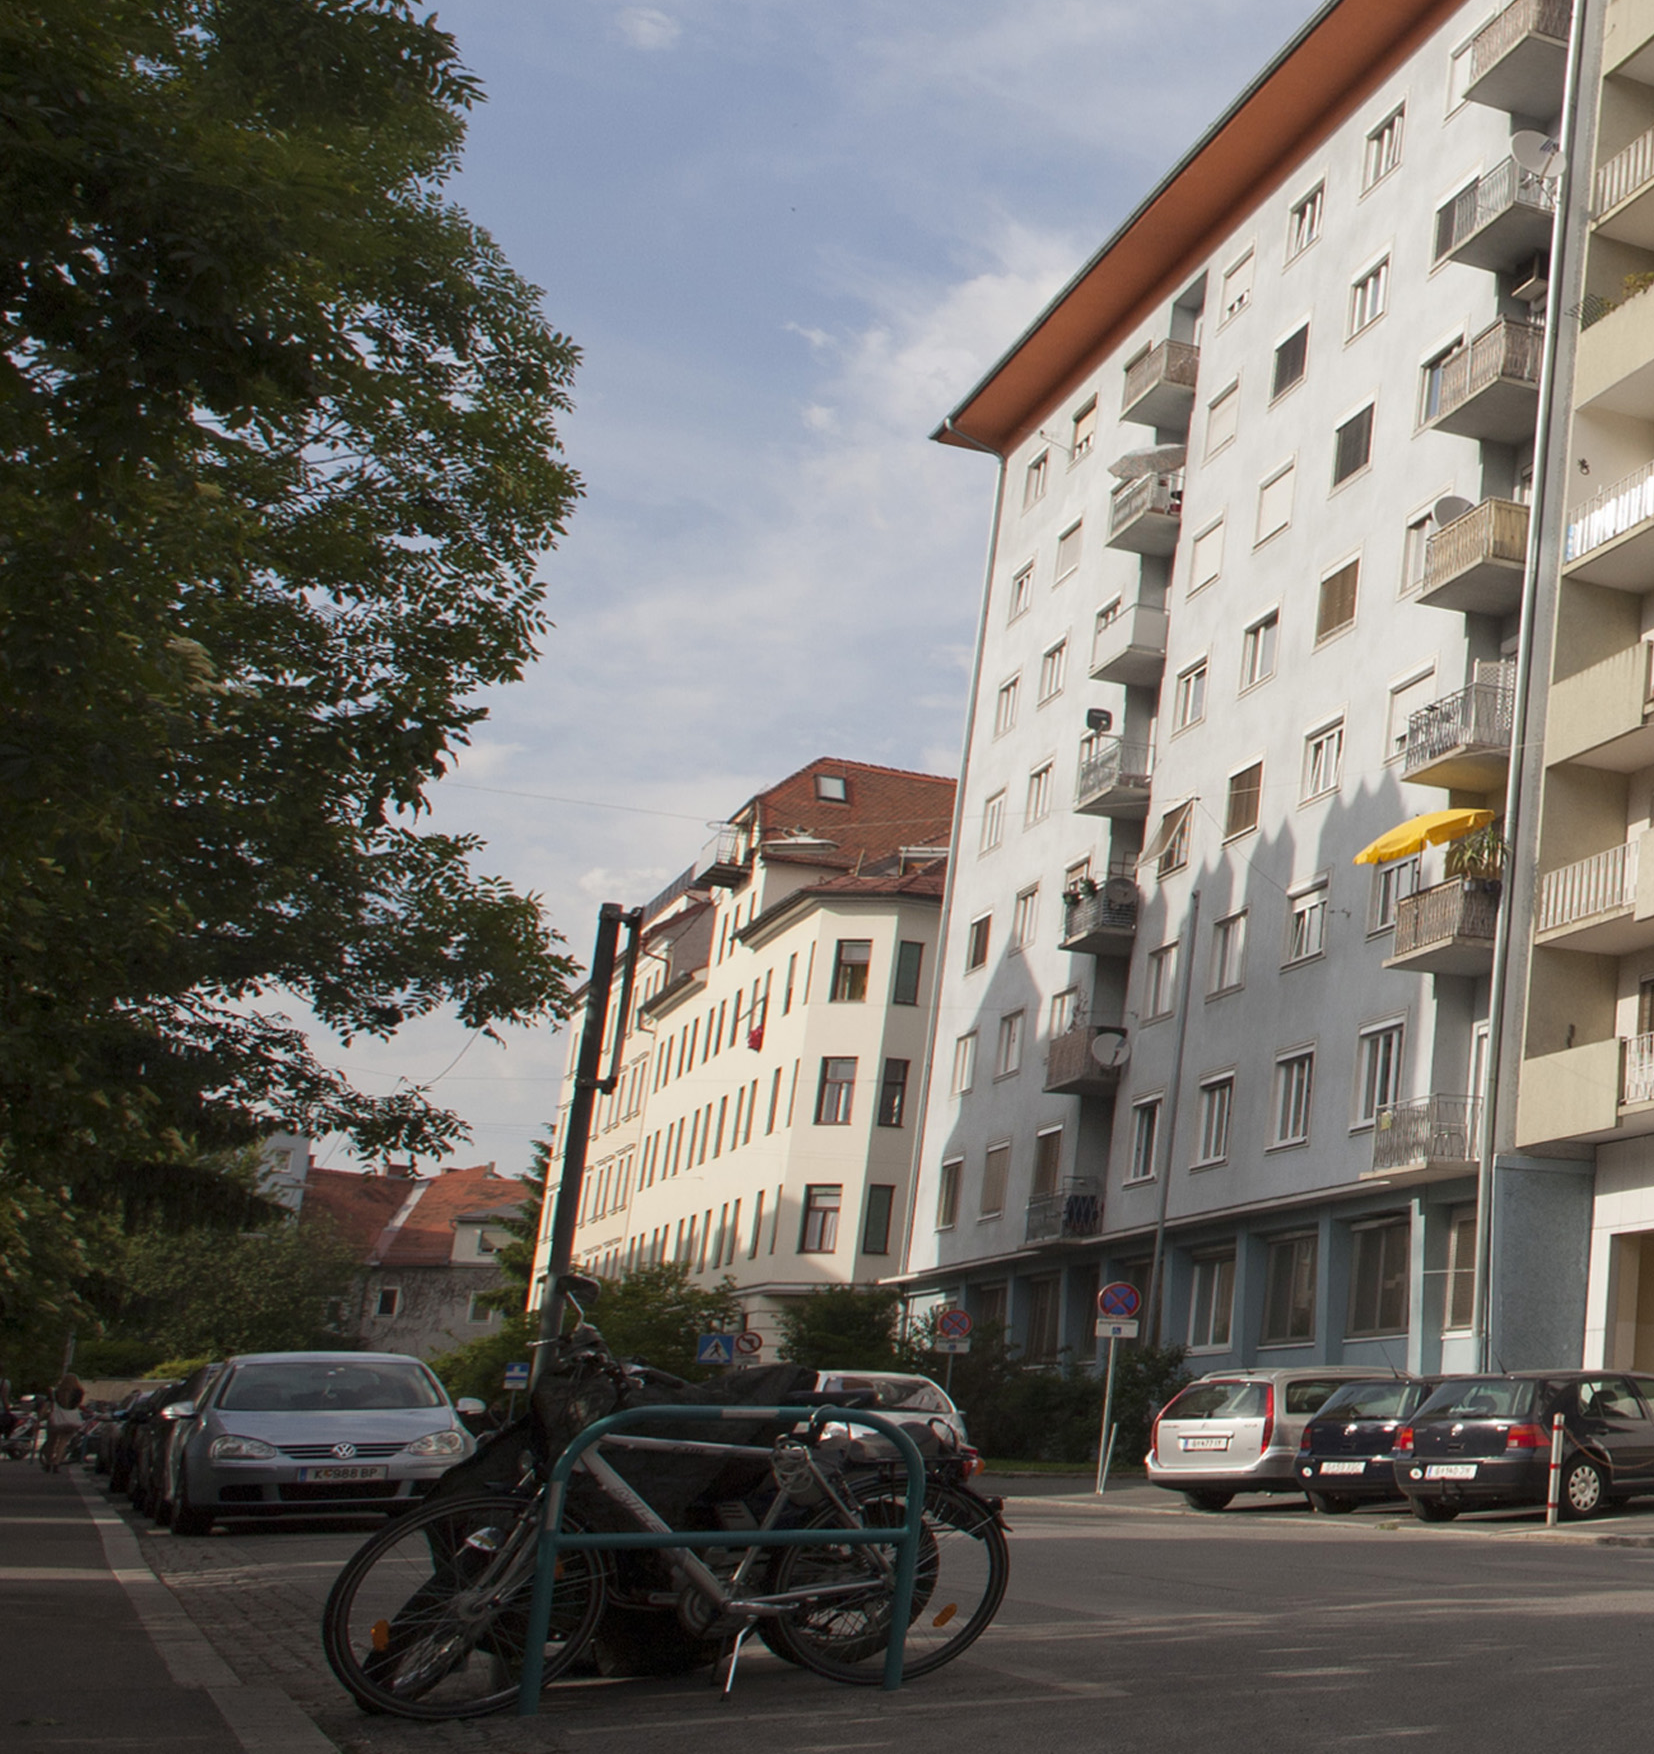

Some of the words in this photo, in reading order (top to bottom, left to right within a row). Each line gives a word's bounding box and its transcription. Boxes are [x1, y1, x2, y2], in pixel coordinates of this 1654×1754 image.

[314, 1469, 323, 1479] K
[333, 1468, 359, 1479] 988
[361, 1467, 378, 1479] BP
